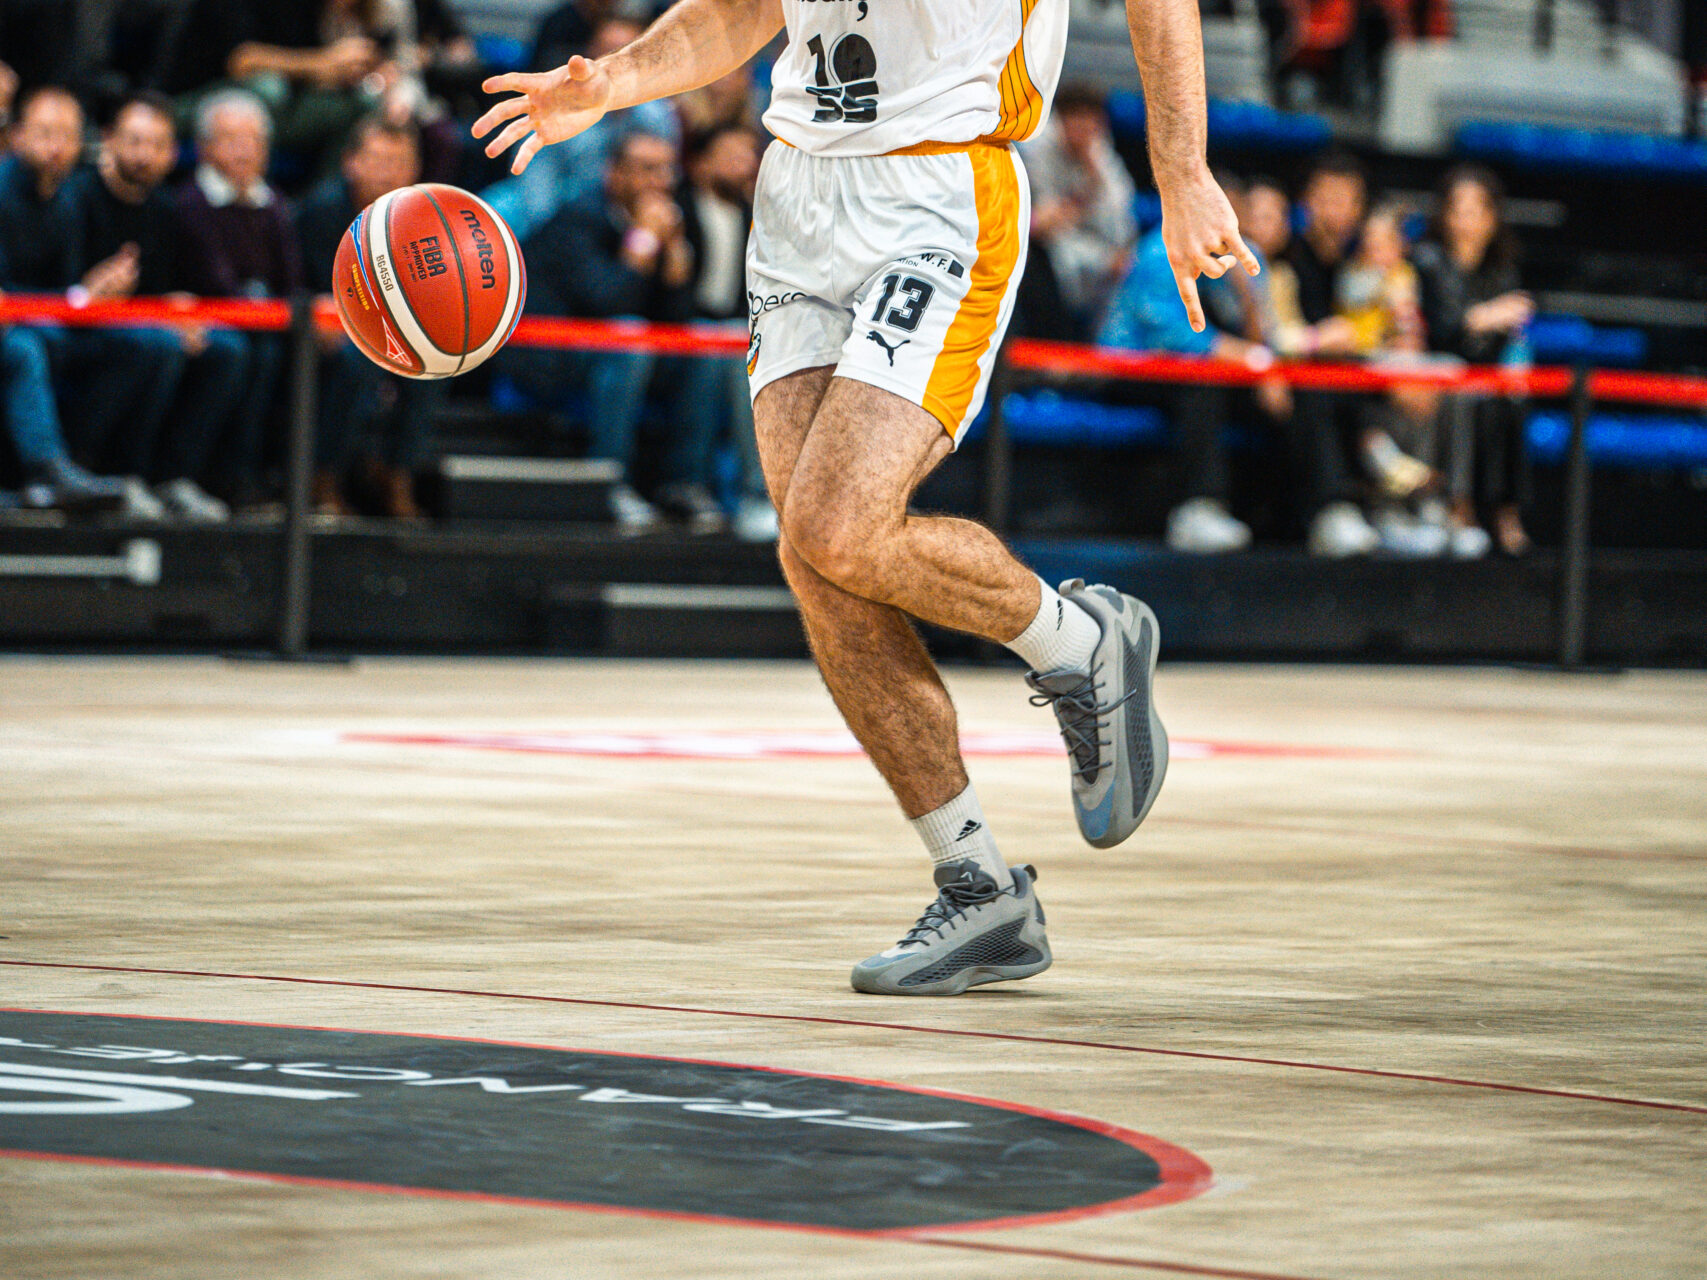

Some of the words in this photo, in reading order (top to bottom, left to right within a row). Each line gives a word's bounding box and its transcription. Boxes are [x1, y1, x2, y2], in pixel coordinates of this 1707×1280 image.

[410, 241, 427, 280] APPROVED
[419, 236, 447, 277] FIBA
[460, 210, 496, 290] molten
[376, 254, 394, 291] BG4550
[871, 273, 936, 333] 13
